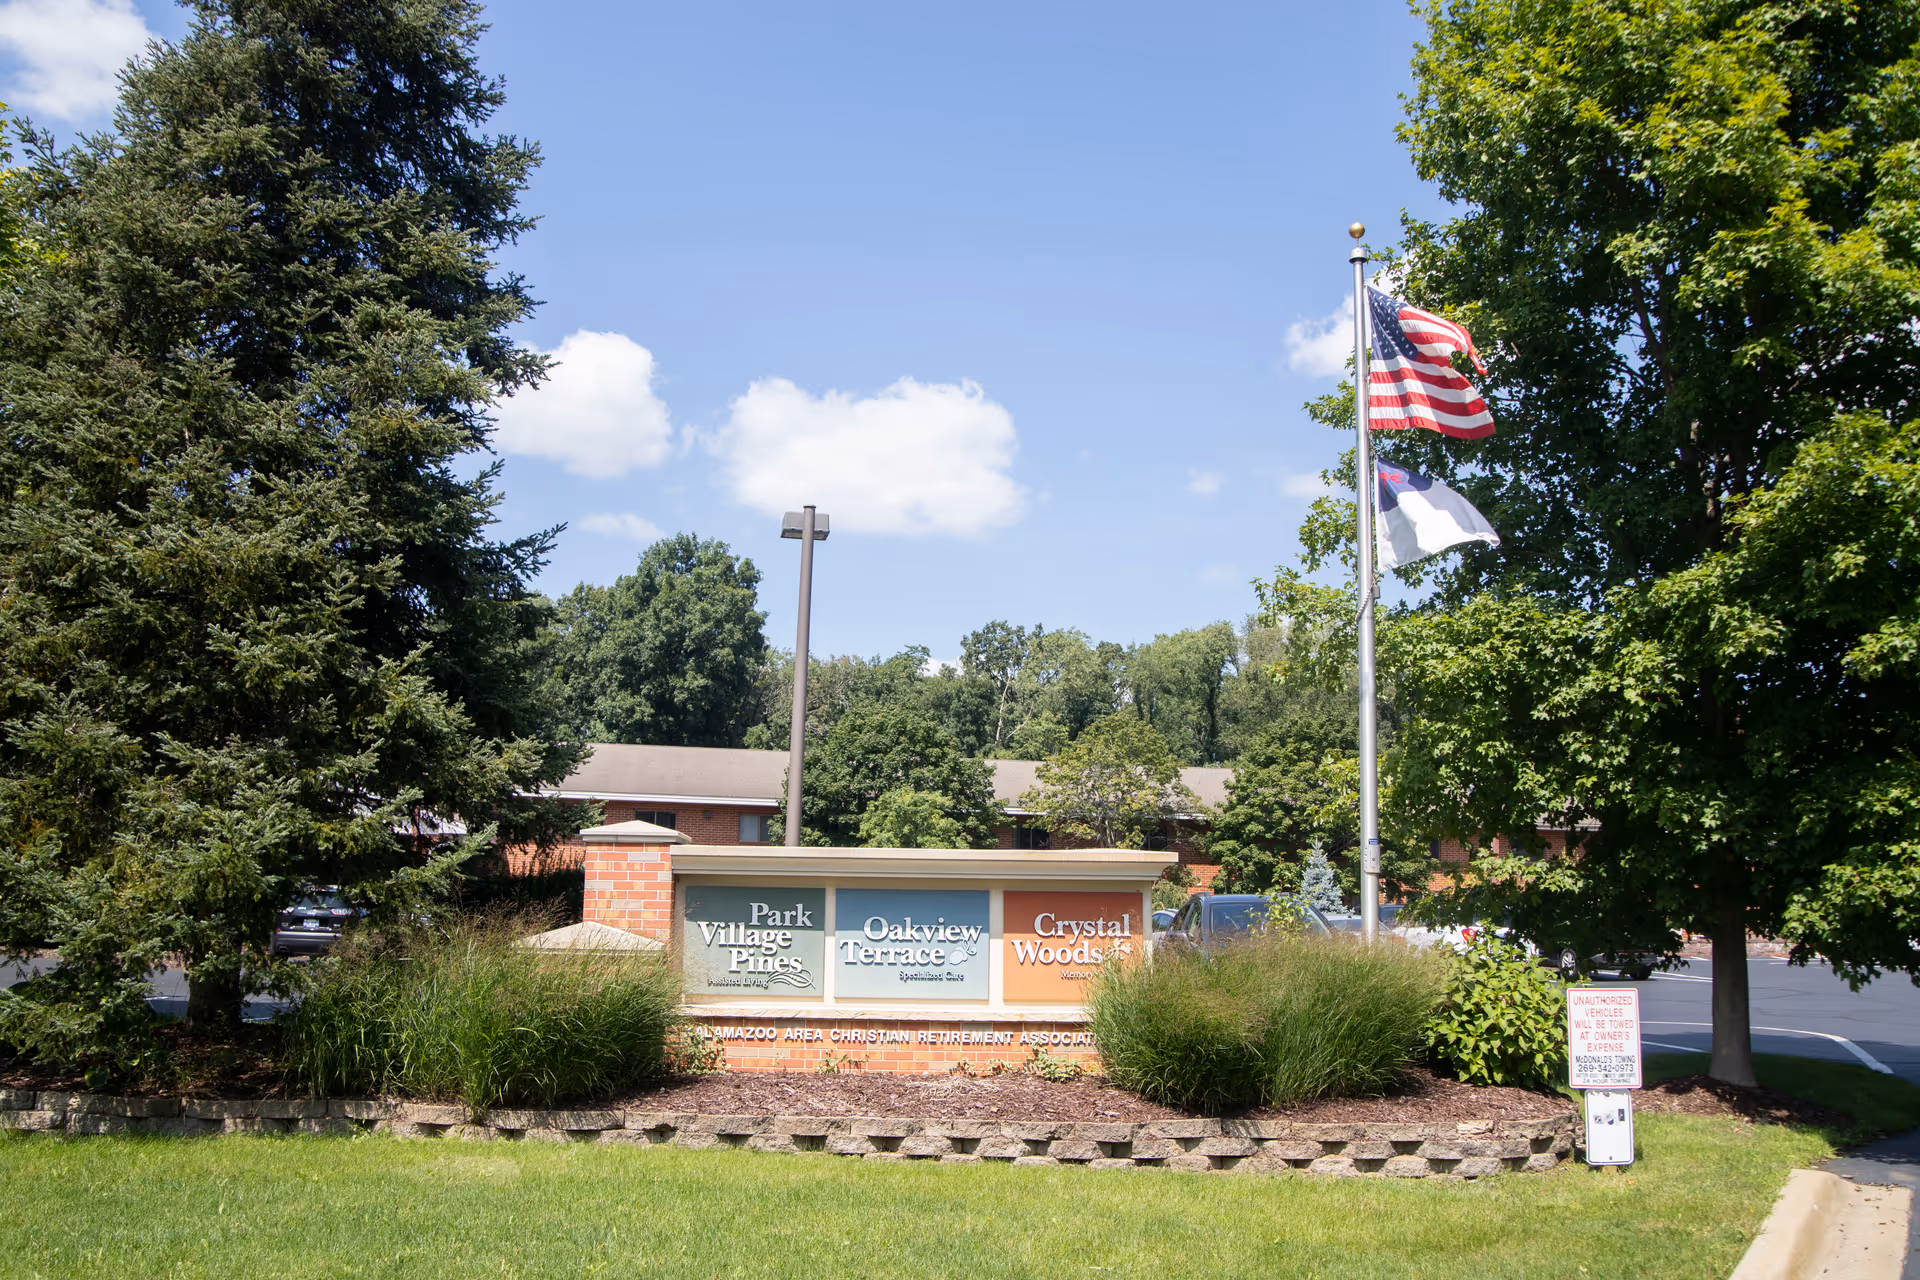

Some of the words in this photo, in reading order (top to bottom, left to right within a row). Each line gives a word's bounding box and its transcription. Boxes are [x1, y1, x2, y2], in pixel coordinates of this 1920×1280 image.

[749, 902, 813, 927] Park
[863, 916, 982, 943] Oakview
[1034, 912, 1131, 945] Crystal
[697, 921, 792, 956] Village
[840, 939, 945, 966] Terrace
[1011, 939, 1103, 965] Woods
[728, 948, 802, 974] Pines
[899, 970, 943, 983] Specialized
[946, 971, 964, 981] Care
[1061, 969, 1094, 981] Memory
[707, 976, 741, 987] Assisted
[743, 976, 769, 989] Living
[1573, 996, 1633, 1006] UNAUTHORIZED
[1585, 1008, 1624, 1018] VEHICLES
[1574, 1020, 1593, 1029] WILL
[1596, 1020, 1606, 1029] BE
[1609, 1020, 1634, 1029] TOWED
[684, 1025, 777, 1040] ALAMAZOO
[784, 1028, 823, 1041] AREA
[830, 1029, 909, 1043] CHRISTIAN
[917, 1031, 1013, 1045] RETIREMENT
[1020, 1032, 1098, 1046] ASSOCIAT
[1579, 1031, 1590, 1041] AT
[1594, 1031, 1631, 1041] OWNER'S
[1587, 1043, 1625, 1053] EXPENSE
[1614, 1055, 1636, 1064] TOWING
[1578, 1064, 1634, 1073] 269-342-0973
